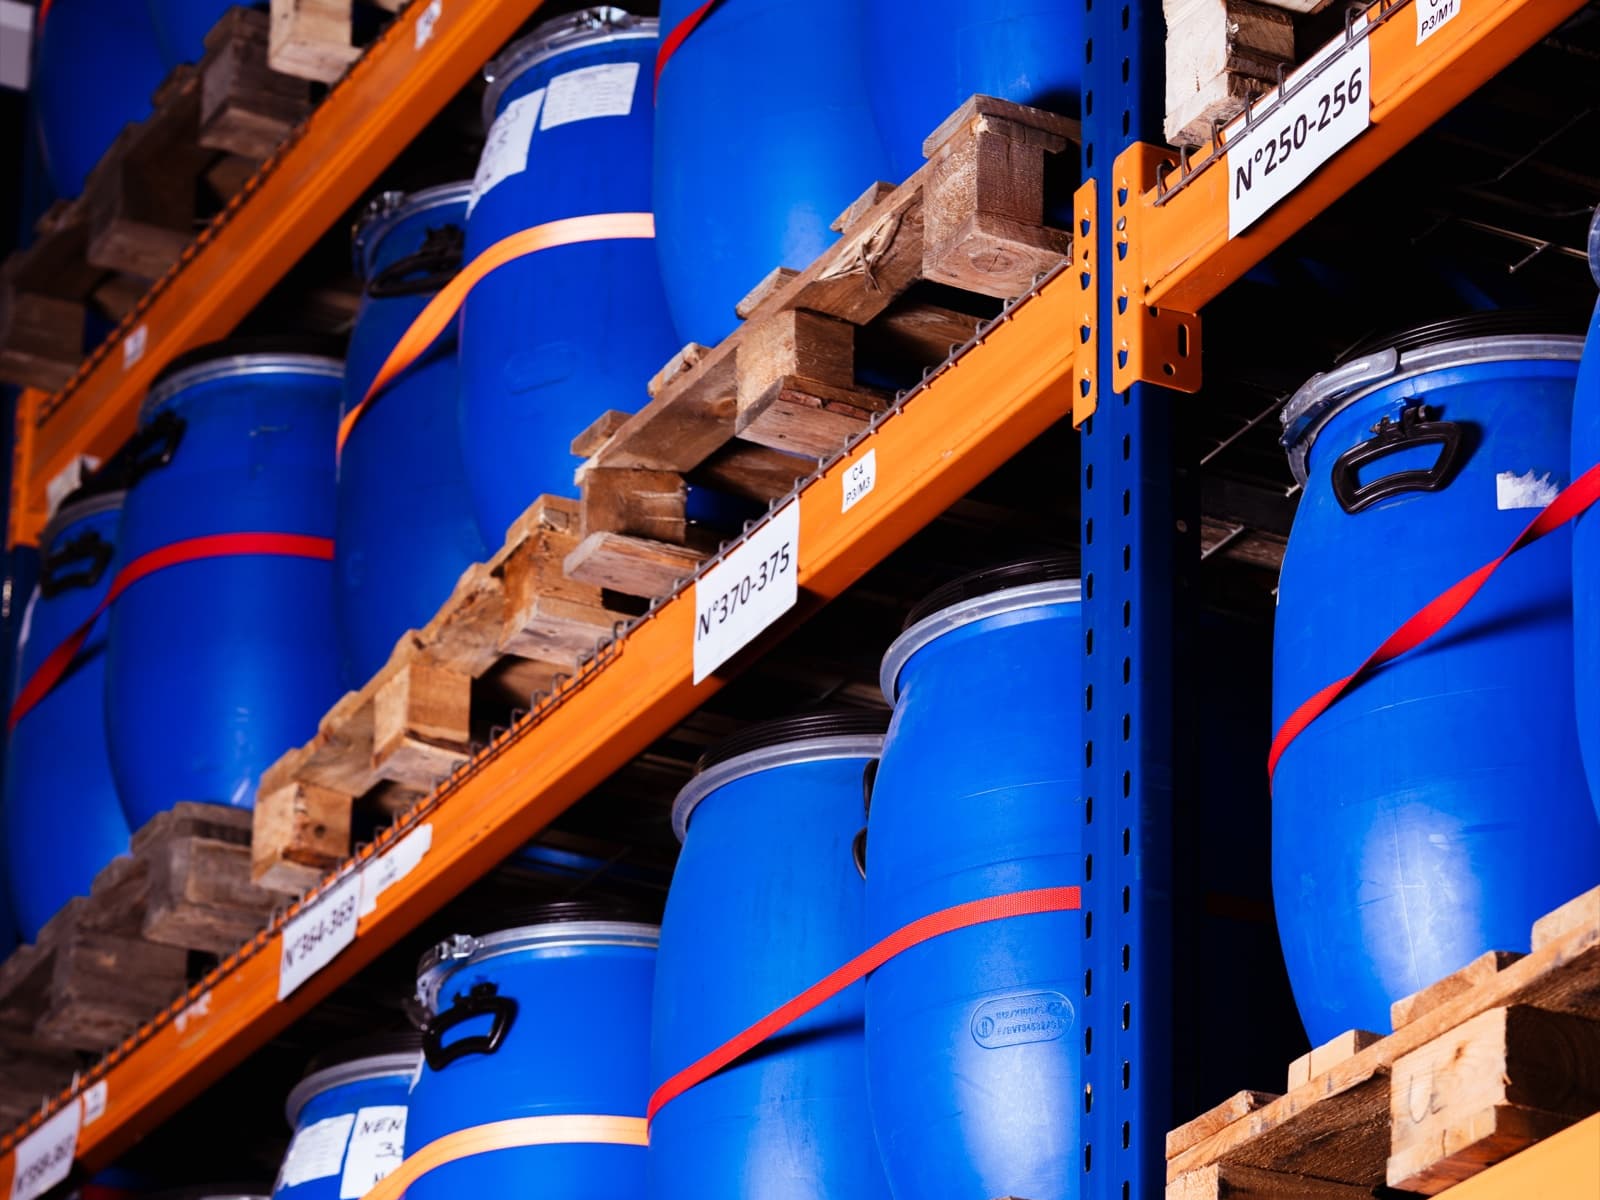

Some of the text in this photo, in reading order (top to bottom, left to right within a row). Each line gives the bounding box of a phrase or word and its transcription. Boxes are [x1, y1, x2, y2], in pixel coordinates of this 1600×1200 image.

[1421, 0, 1454, 36] P3/M1
[1235, 67, 1362, 200] N°250-256
[698, 542, 790, 641] N°370-375
